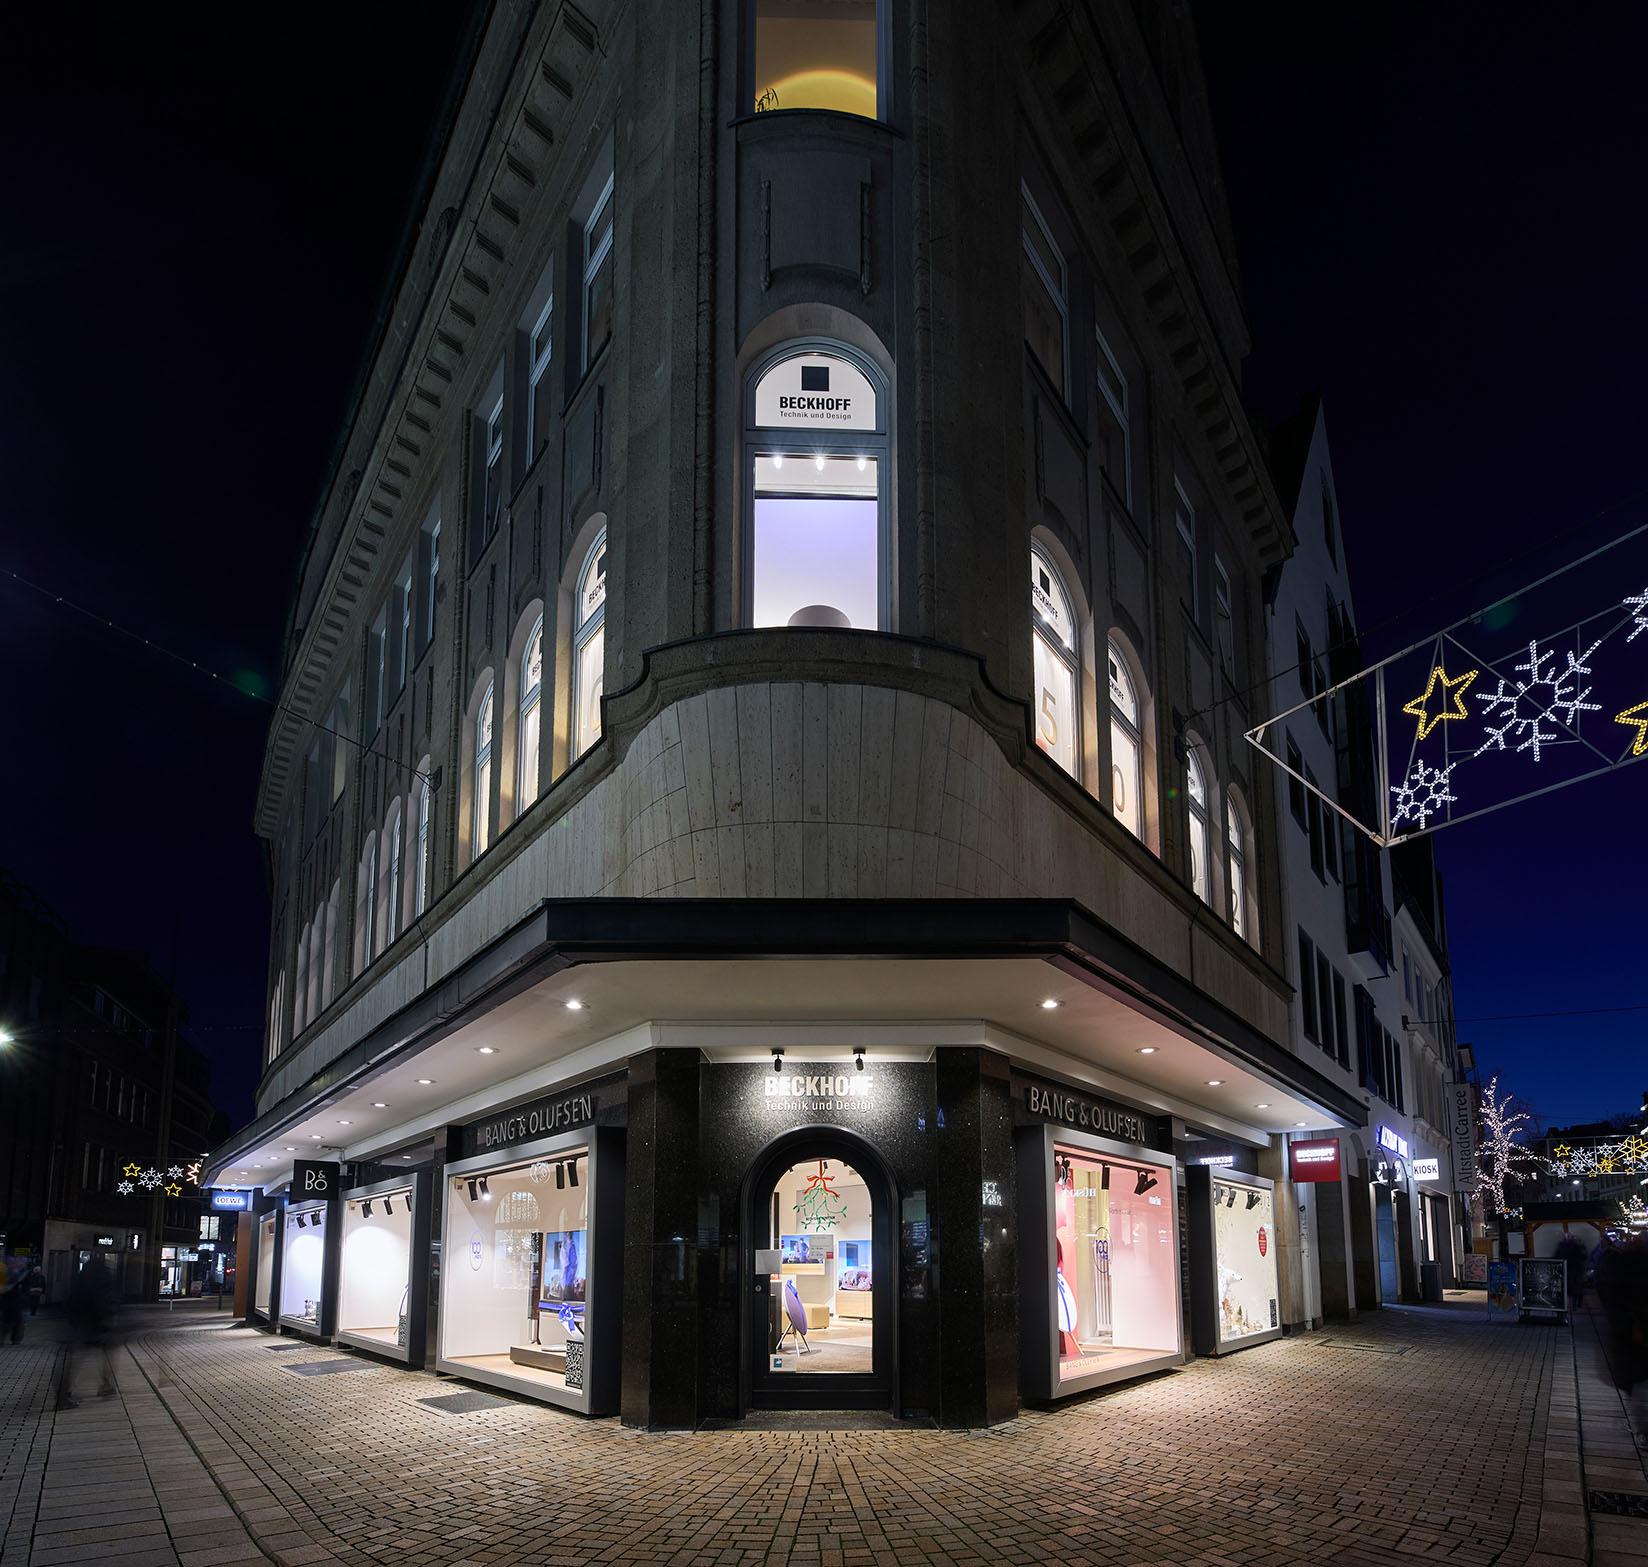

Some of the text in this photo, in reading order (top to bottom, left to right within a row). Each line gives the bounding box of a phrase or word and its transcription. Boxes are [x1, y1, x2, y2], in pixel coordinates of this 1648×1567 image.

[779, 396, 851, 411] BECKHOFF
[826, 412, 852, 420] Design
[764, 1076, 874, 1097] BECKHOFF
[765, 1101, 874, 1113] Technik und Design
[1031, 1086, 1145, 1142] BANG & OLUFSEN
[485, 1095, 592, 1147] BANG & OLUFSEN
[1455, 1089, 1473, 1185] AltstadtCarree
[1413, 1165, 1438, 1175] KIOSK
